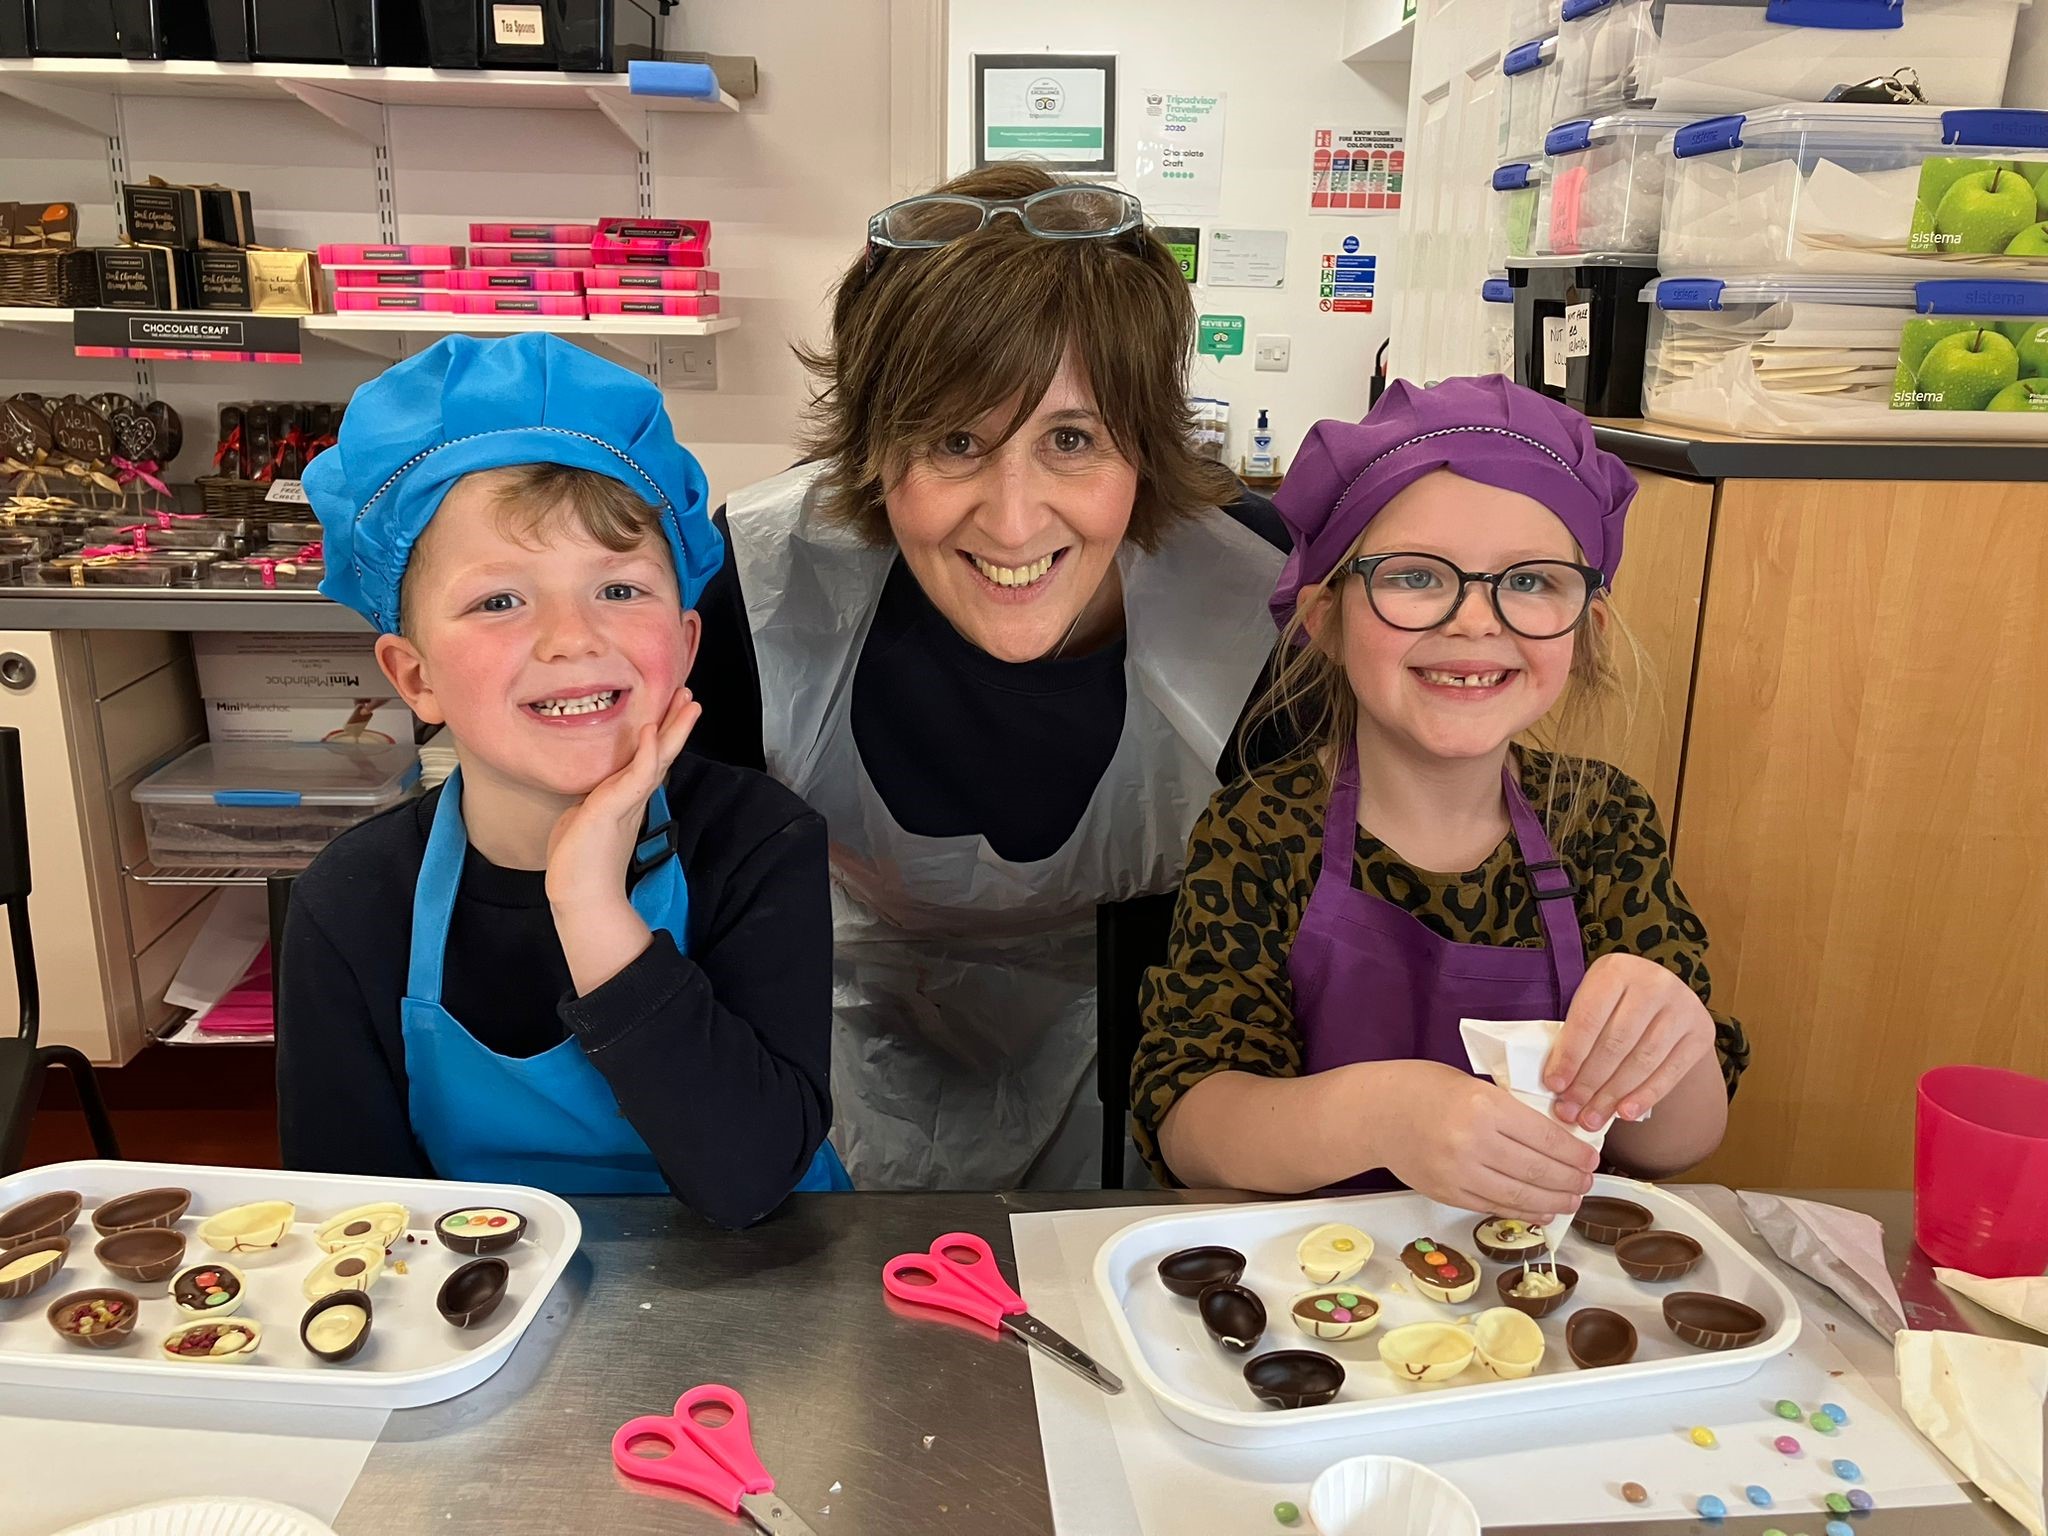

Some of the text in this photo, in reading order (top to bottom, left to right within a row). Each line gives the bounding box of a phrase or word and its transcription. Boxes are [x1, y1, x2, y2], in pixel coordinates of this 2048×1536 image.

[501, 20, 536, 36] Tea Spoons
[1166, 95, 1217, 105] Tripadvisor
[1165, 114, 1198, 123] Choice
[1163, 148, 1204, 157] Choolate
[1912, 231, 1962, 244] sistema
[1181, 261, 1189, 271] 5
[1966, 290, 2025, 305] sistema
[142, 323, 229, 335] CHOCOLATE CRAFT
[1550, 328, 1563, 342] NUT
[1894, 390, 1943, 402] sistema
[60, 410, 98, 432] Well
[59, 430, 105, 456] Done!
